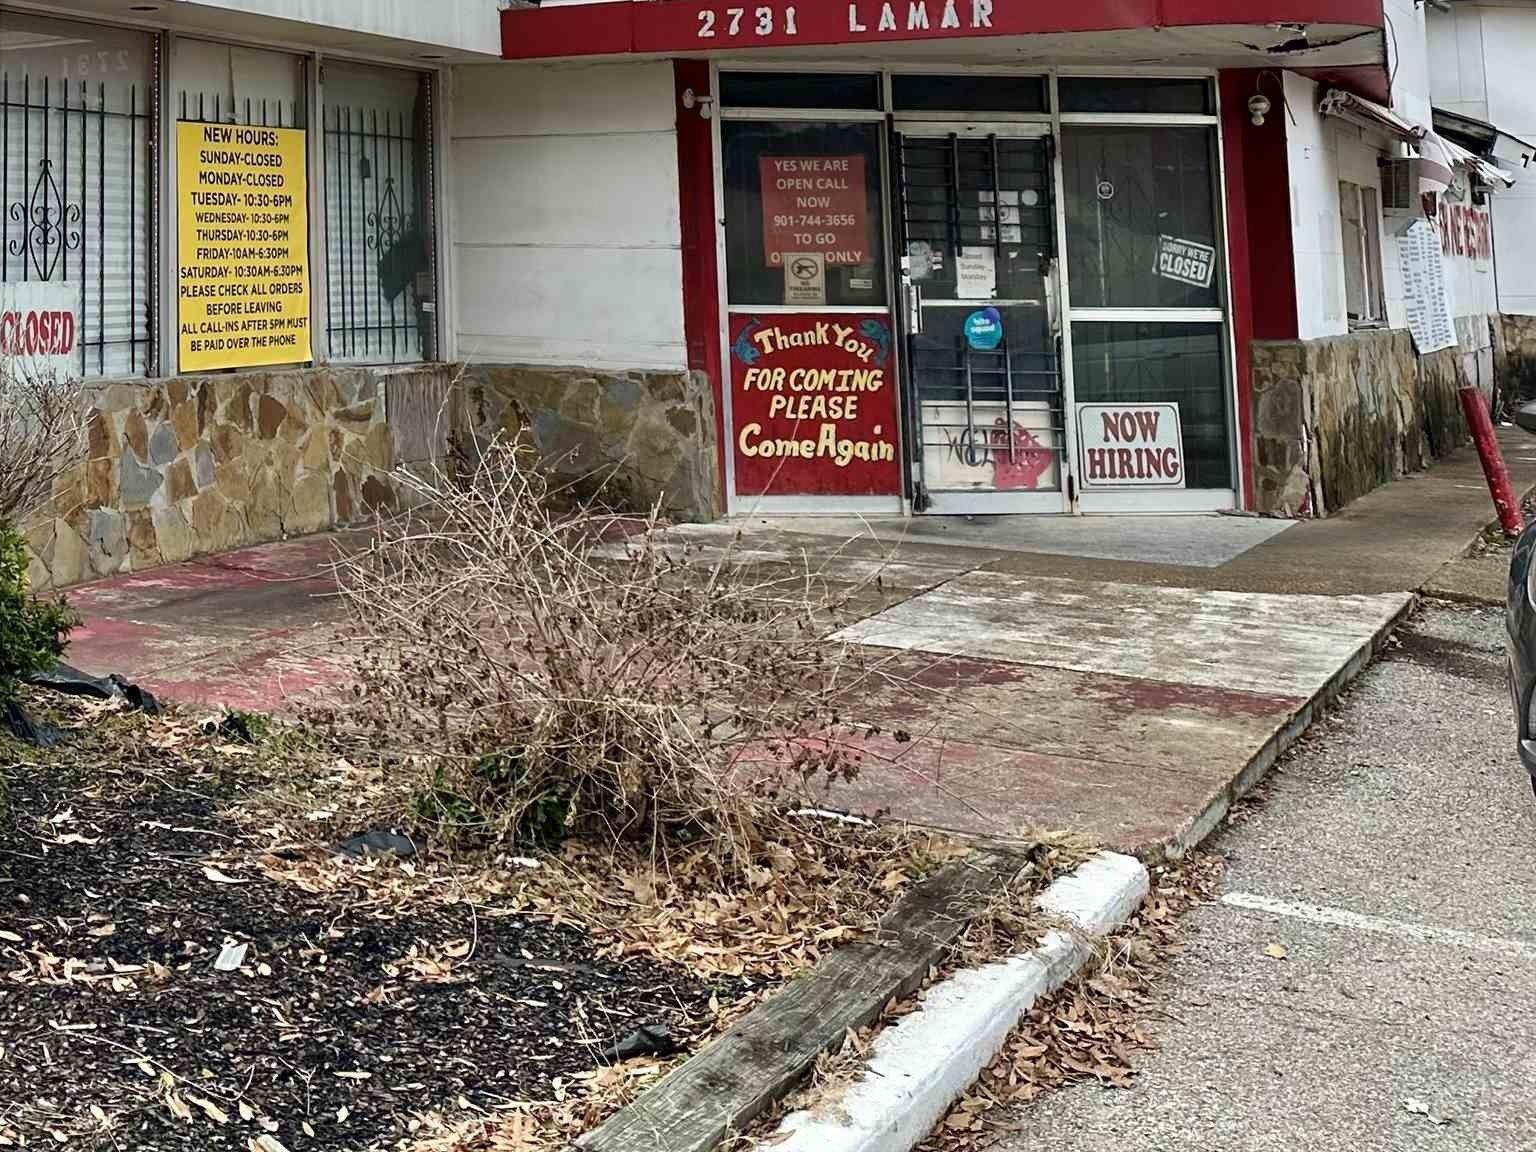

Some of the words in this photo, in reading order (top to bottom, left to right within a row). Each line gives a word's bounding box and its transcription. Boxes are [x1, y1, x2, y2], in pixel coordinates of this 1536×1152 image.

[697, 5, 797, 38] 2731
[204, 127, 232, 144] NEW
[236, 129, 279, 147] HOURS:
[200, 150, 283, 167] SUNDAY-CLOSED
[774, 160, 797, 172] YES
[800, 160, 821, 171] WE
[823, 159, 848, 171] ARE
[199, 171, 284, 187] MONDAY-CLOSED
[776, 178, 813, 190] OPEN
[816, 177, 848, 189] CALL
[191, 192, 241, 206] TUESDAY-
[244, 193, 292, 207] 10:30-6PM
[796, 197, 831, 208] NOW
[196, 212, 249, 223] WEDNESDAY-
[251, 213, 289, 224] 10:30-6PM
[774, 215, 855, 227] 901-744-3656
[793, 233, 812, 245] TO
[815, 233, 837, 245] GO
[825, 251, 862, 263] ONLY
[1159, 252, 1207, 281] CLOSED
[181, 284, 216, 298] PLEASE
[218, 284, 249, 297] CHECK
[251, 284, 267, 296] ALL
[269, 282, 303, 294] ORDERS
[207, 303, 242, 316] BEFORE
[244, 301, 282, 313] LEAVING
[0, 310, 75, 357] CLOSED
[181, 323, 198, 335] ALL
[200, 320, 240, 334] CALL-INS
[241, 319, 268, 331] AFTER
[269, 317, 285, 329] 5PM
[286, 316, 308, 329] MUST
[191, 340, 202, 352] BE
[204, 339, 224, 351] PAID
[226, 337, 249, 349] OVER
[252, 335, 267, 347] THE
[269, 334, 296, 346] PHONE
[832, 322, 875, 363] You
[743, 367, 786, 392] FOR
[789, 367, 884, 392] COMING
[768, 394, 859, 420] PLEASE
[1100, 411, 1160, 443] NOW
[739, 422, 816, 459] Come
[816, 422, 895, 467] Again
[1087, 447, 1180, 480] HIRING
